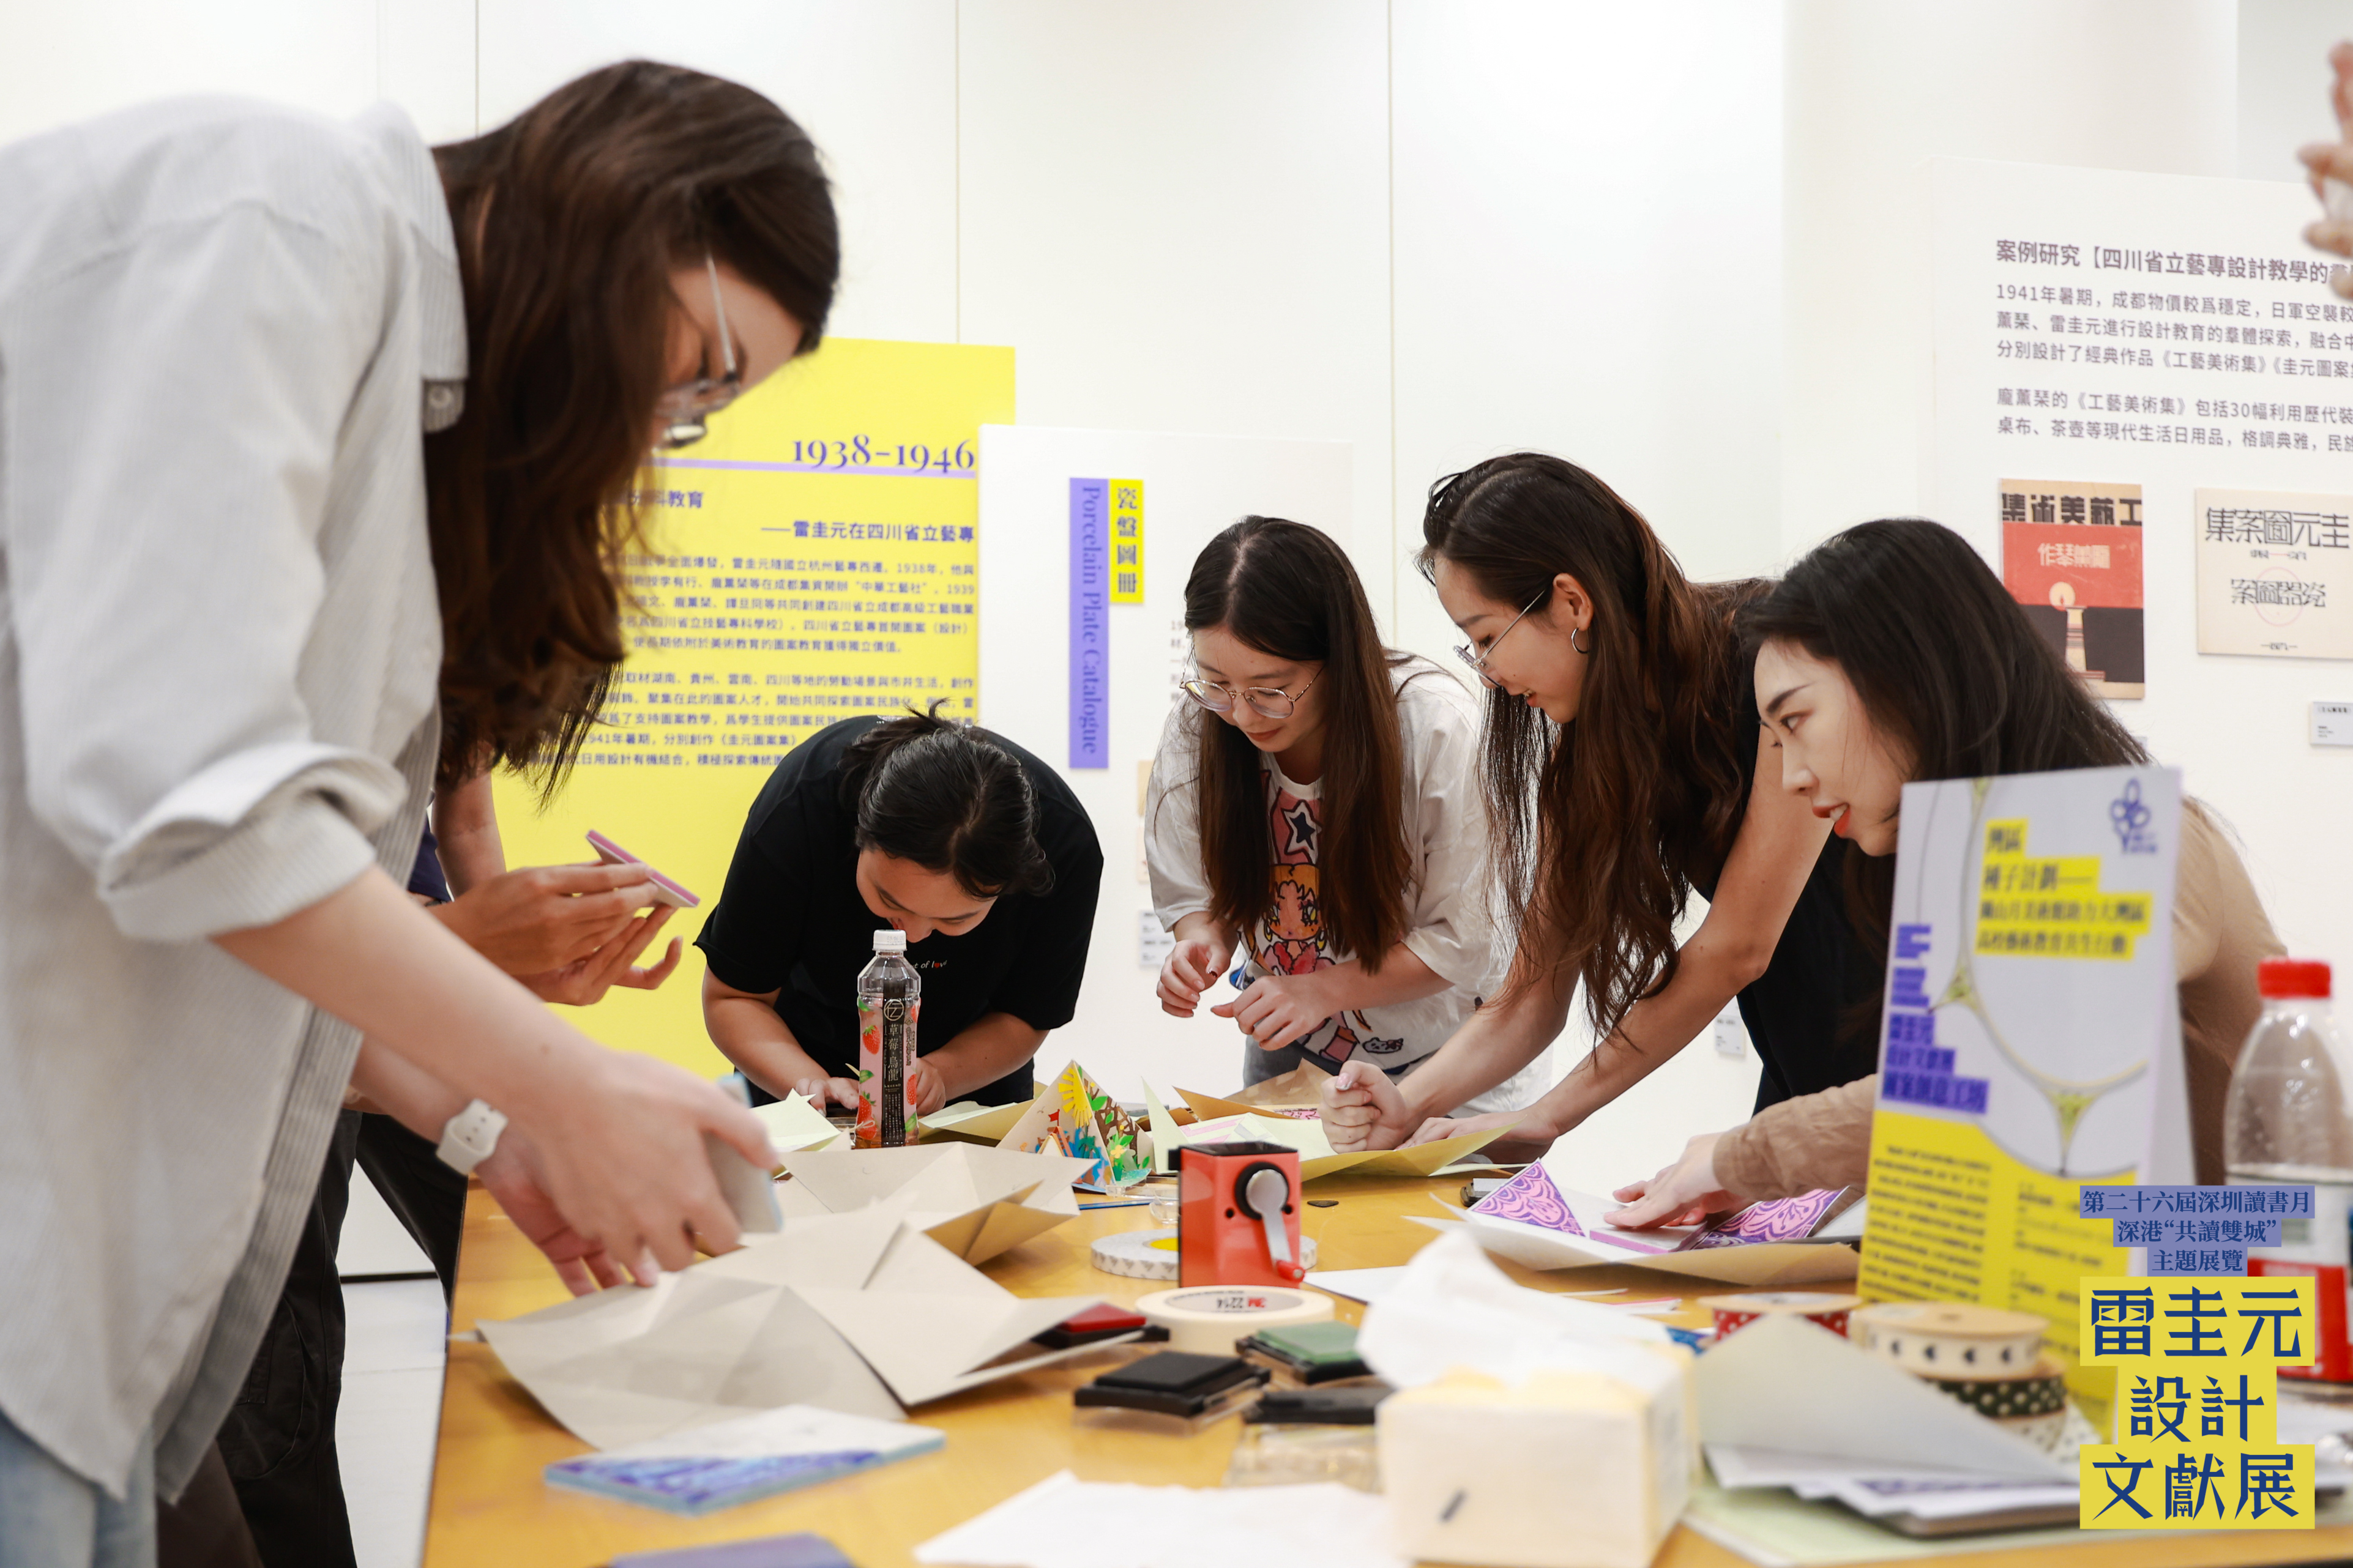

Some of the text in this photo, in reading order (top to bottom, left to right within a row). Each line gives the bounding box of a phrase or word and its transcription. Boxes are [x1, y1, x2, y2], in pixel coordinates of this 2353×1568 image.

[1996, 240, 2353, 284] 案例研究【四川省立藝專設計教學的
[1079, 486, 1102, 754] Porcelain Plate Catalogue
[920, 960, 930, 969] of
